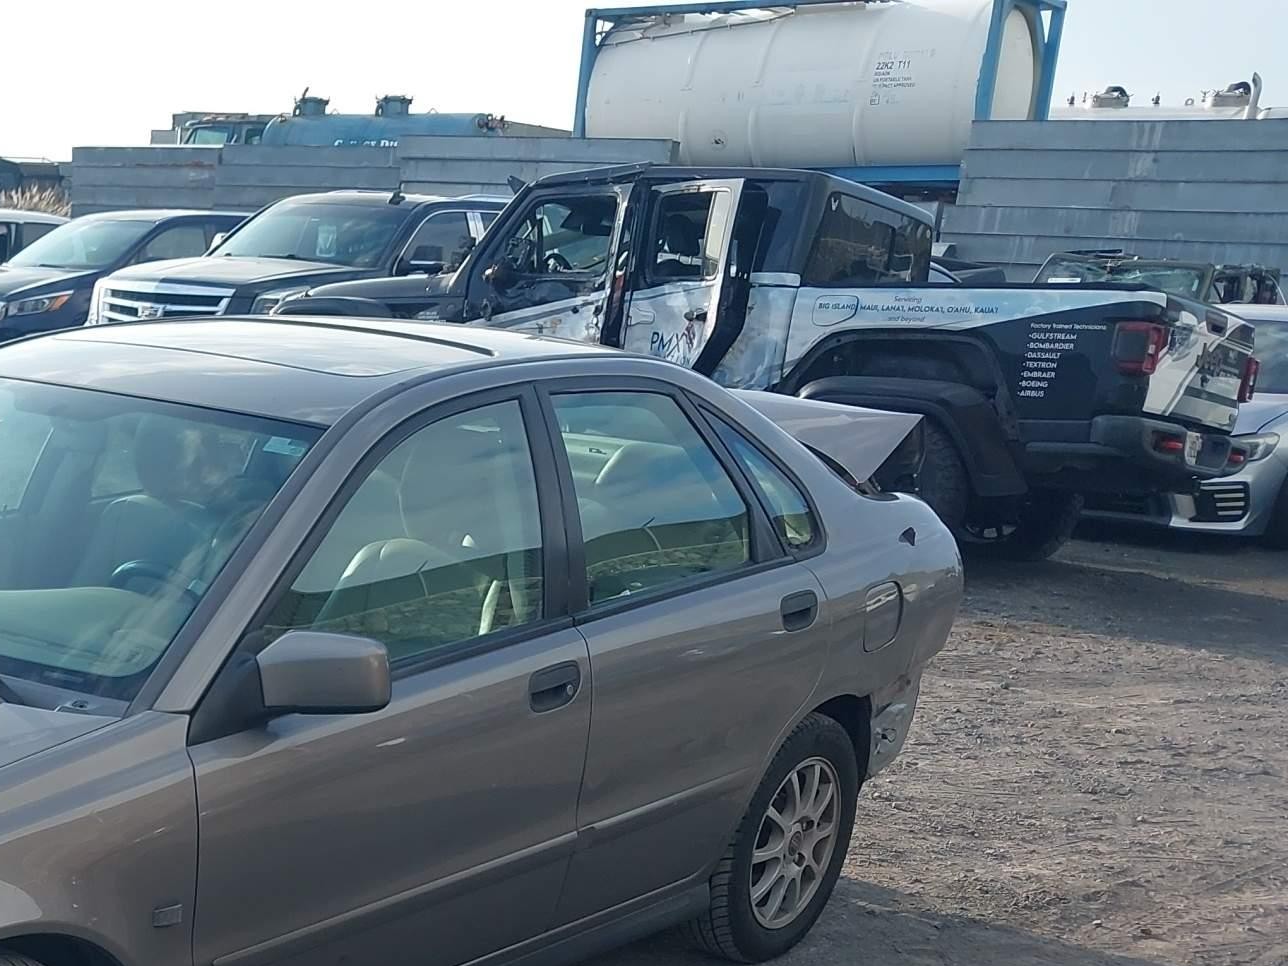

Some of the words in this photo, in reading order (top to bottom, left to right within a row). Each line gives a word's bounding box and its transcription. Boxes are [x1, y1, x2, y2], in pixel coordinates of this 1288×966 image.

[876, 61, 894, 70] 22K2
[898, 60, 911, 69] T11
[818, 302, 830, 310] BIG
[831, 302, 856, 311] ISLAND
